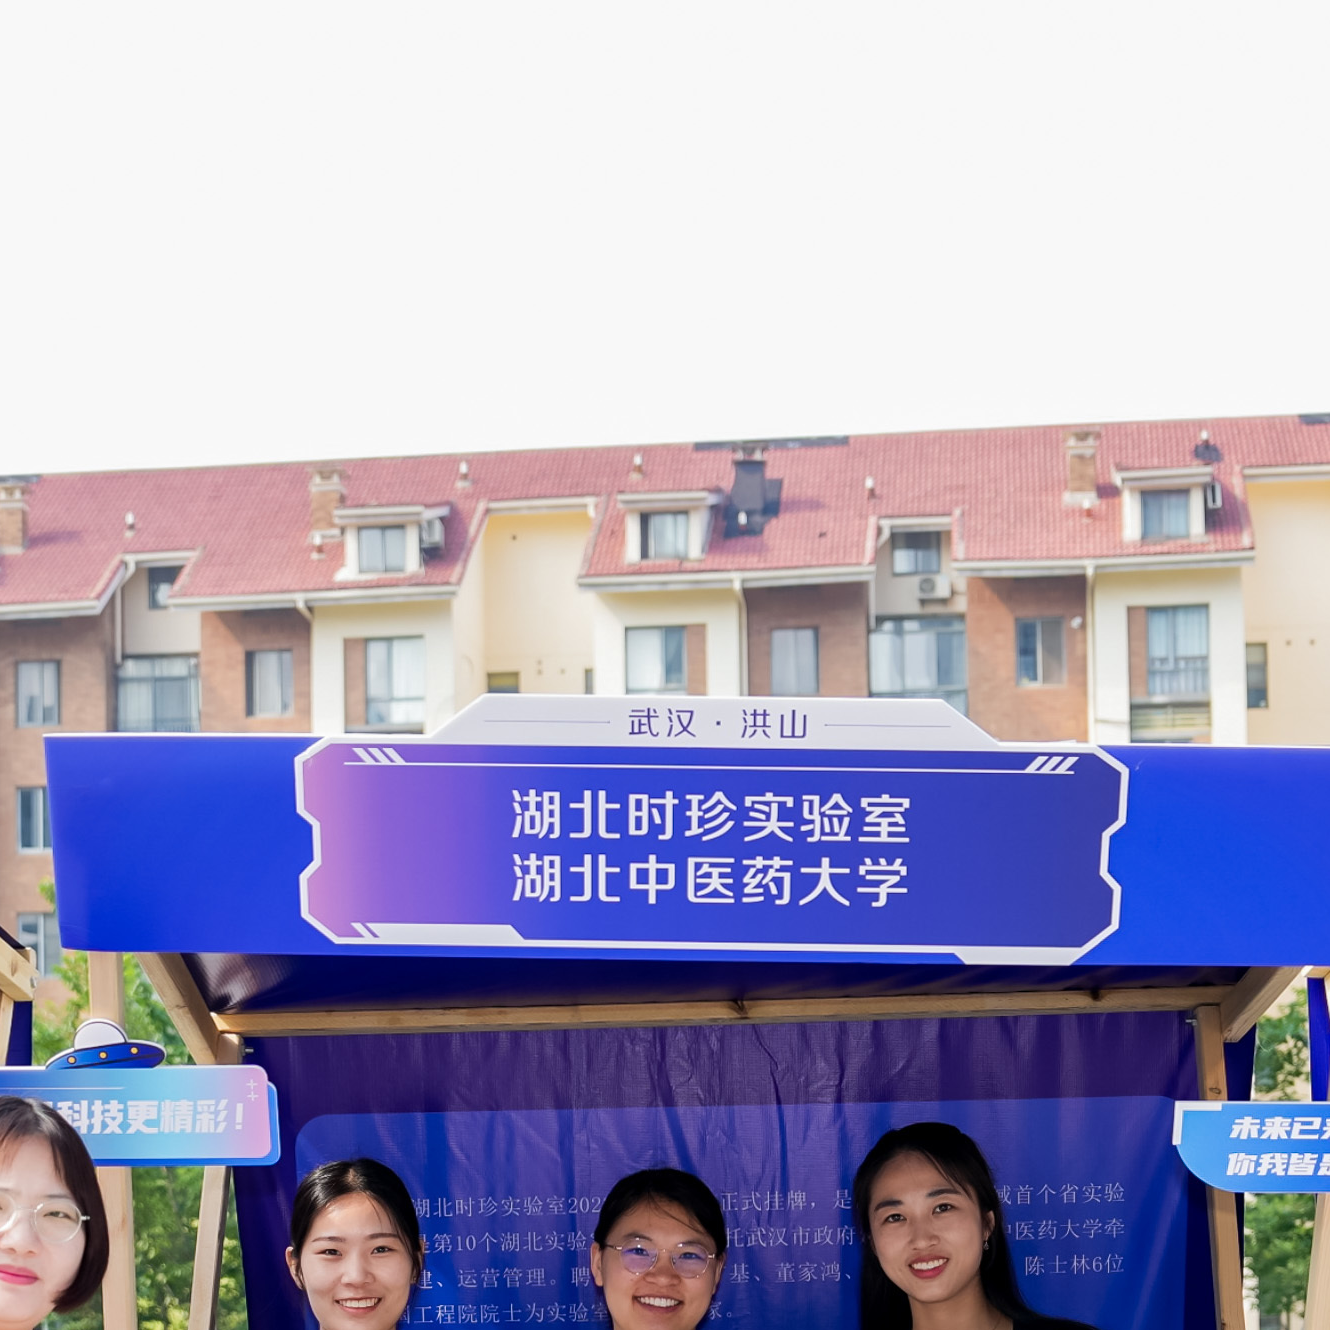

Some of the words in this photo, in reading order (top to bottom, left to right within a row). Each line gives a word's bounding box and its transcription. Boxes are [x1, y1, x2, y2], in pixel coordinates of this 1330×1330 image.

[511, 788, 912, 845] 湖北时珍实验室
[511, 854, 910, 908] 湖北中医药大学
